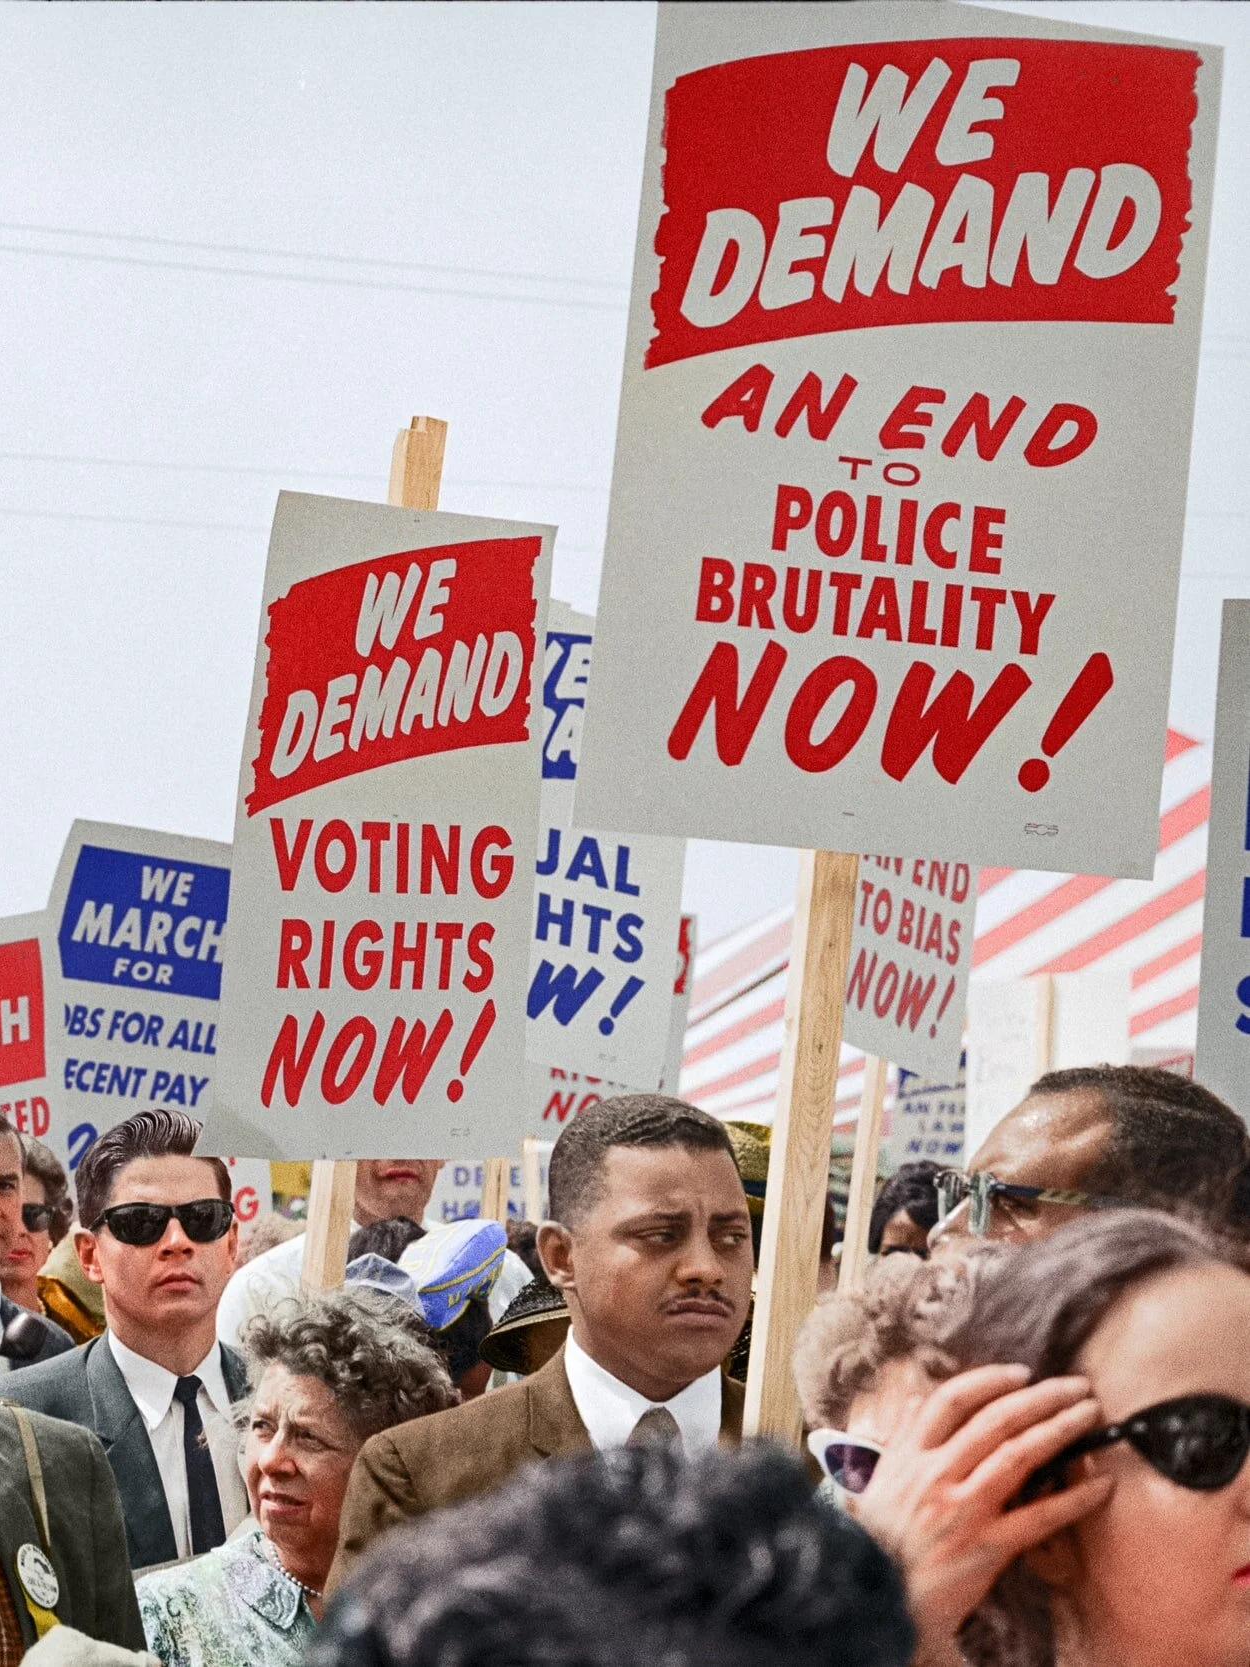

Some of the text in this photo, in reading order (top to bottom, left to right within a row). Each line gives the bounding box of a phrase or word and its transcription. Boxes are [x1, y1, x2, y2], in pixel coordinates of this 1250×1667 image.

[826, 57, 1020, 178] WE
[680, 163, 1163, 328] DEMAND
[701, 364, 1098, 467] AN END
[838, 456, 920, 487] TO
[771, 485, 1007, 575] POLICE
[355, 558, 457, 657] WE
[695, 558, 1055, 655] BRUTALITY
[270, 630, 524, 778] DEMAND
[667, 640, 1113, 792] NOW!
[141, 866, 194, 907] WE
[270, 818, 514, 900] VOTING
[912, 859, 970, 904] END
[71, 900, 227, 963] MARCH
[276, 919, 495, 993] RIGHTS
[860, 879, 961, 967] TO BIAS
[113, 958, 173, 984] FOR
[847, 948, 955, 1038] NOW!
[64, 1003, 216, 1055] BS FOR ALL
[260, 999, 496, 1108] NOW!
[150, 1070, 209, 1107] PAY
